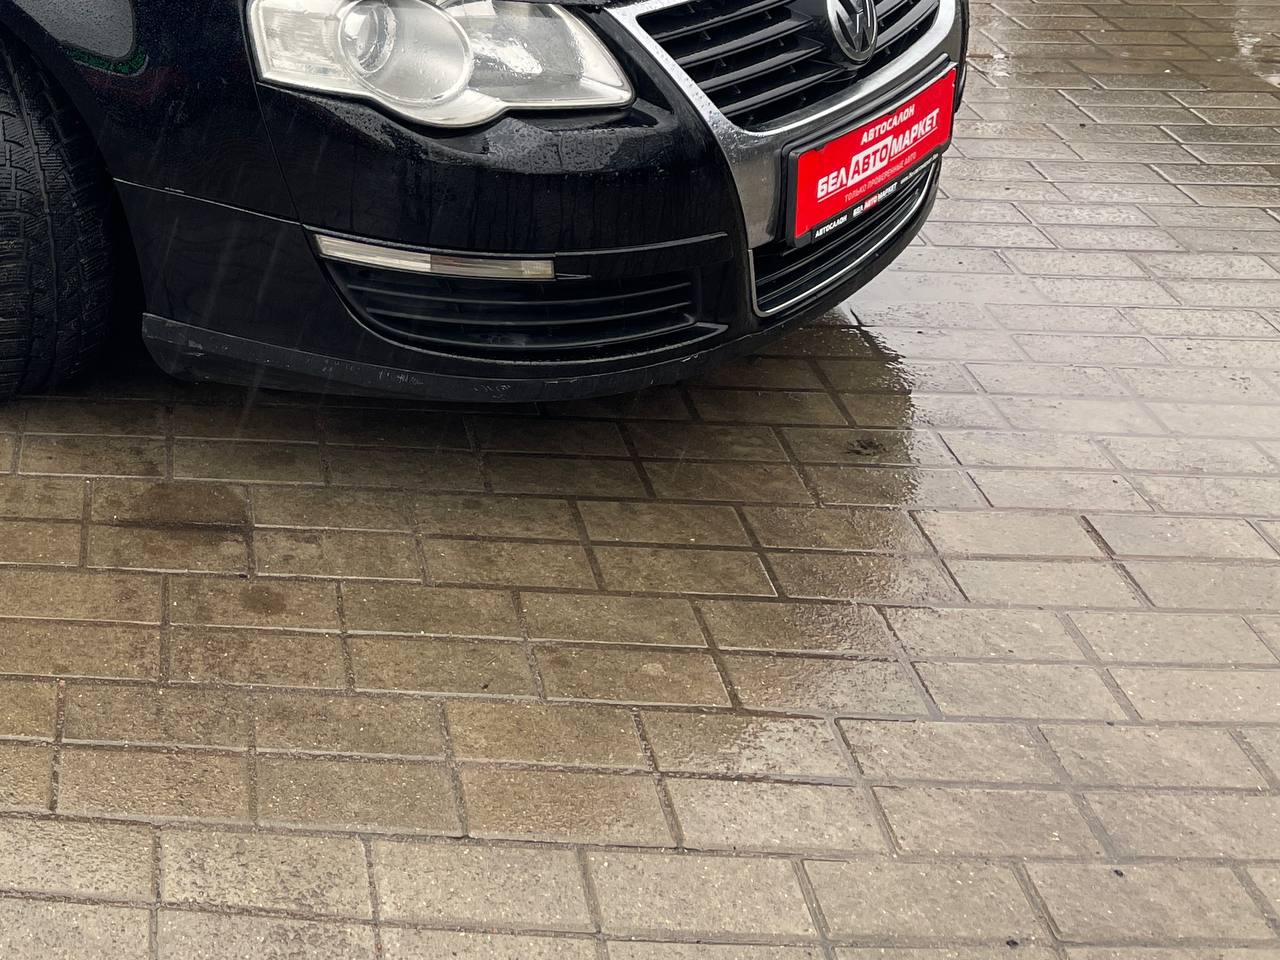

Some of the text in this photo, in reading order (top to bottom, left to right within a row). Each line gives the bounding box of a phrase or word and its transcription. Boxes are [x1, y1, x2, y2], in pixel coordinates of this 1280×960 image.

[860, 103, 916, 146] АВТОСАЛОН
[844, 184, 867, 202] ТОЛЬКО
[815, 214, 848, 238] АВТОСАЛОН
